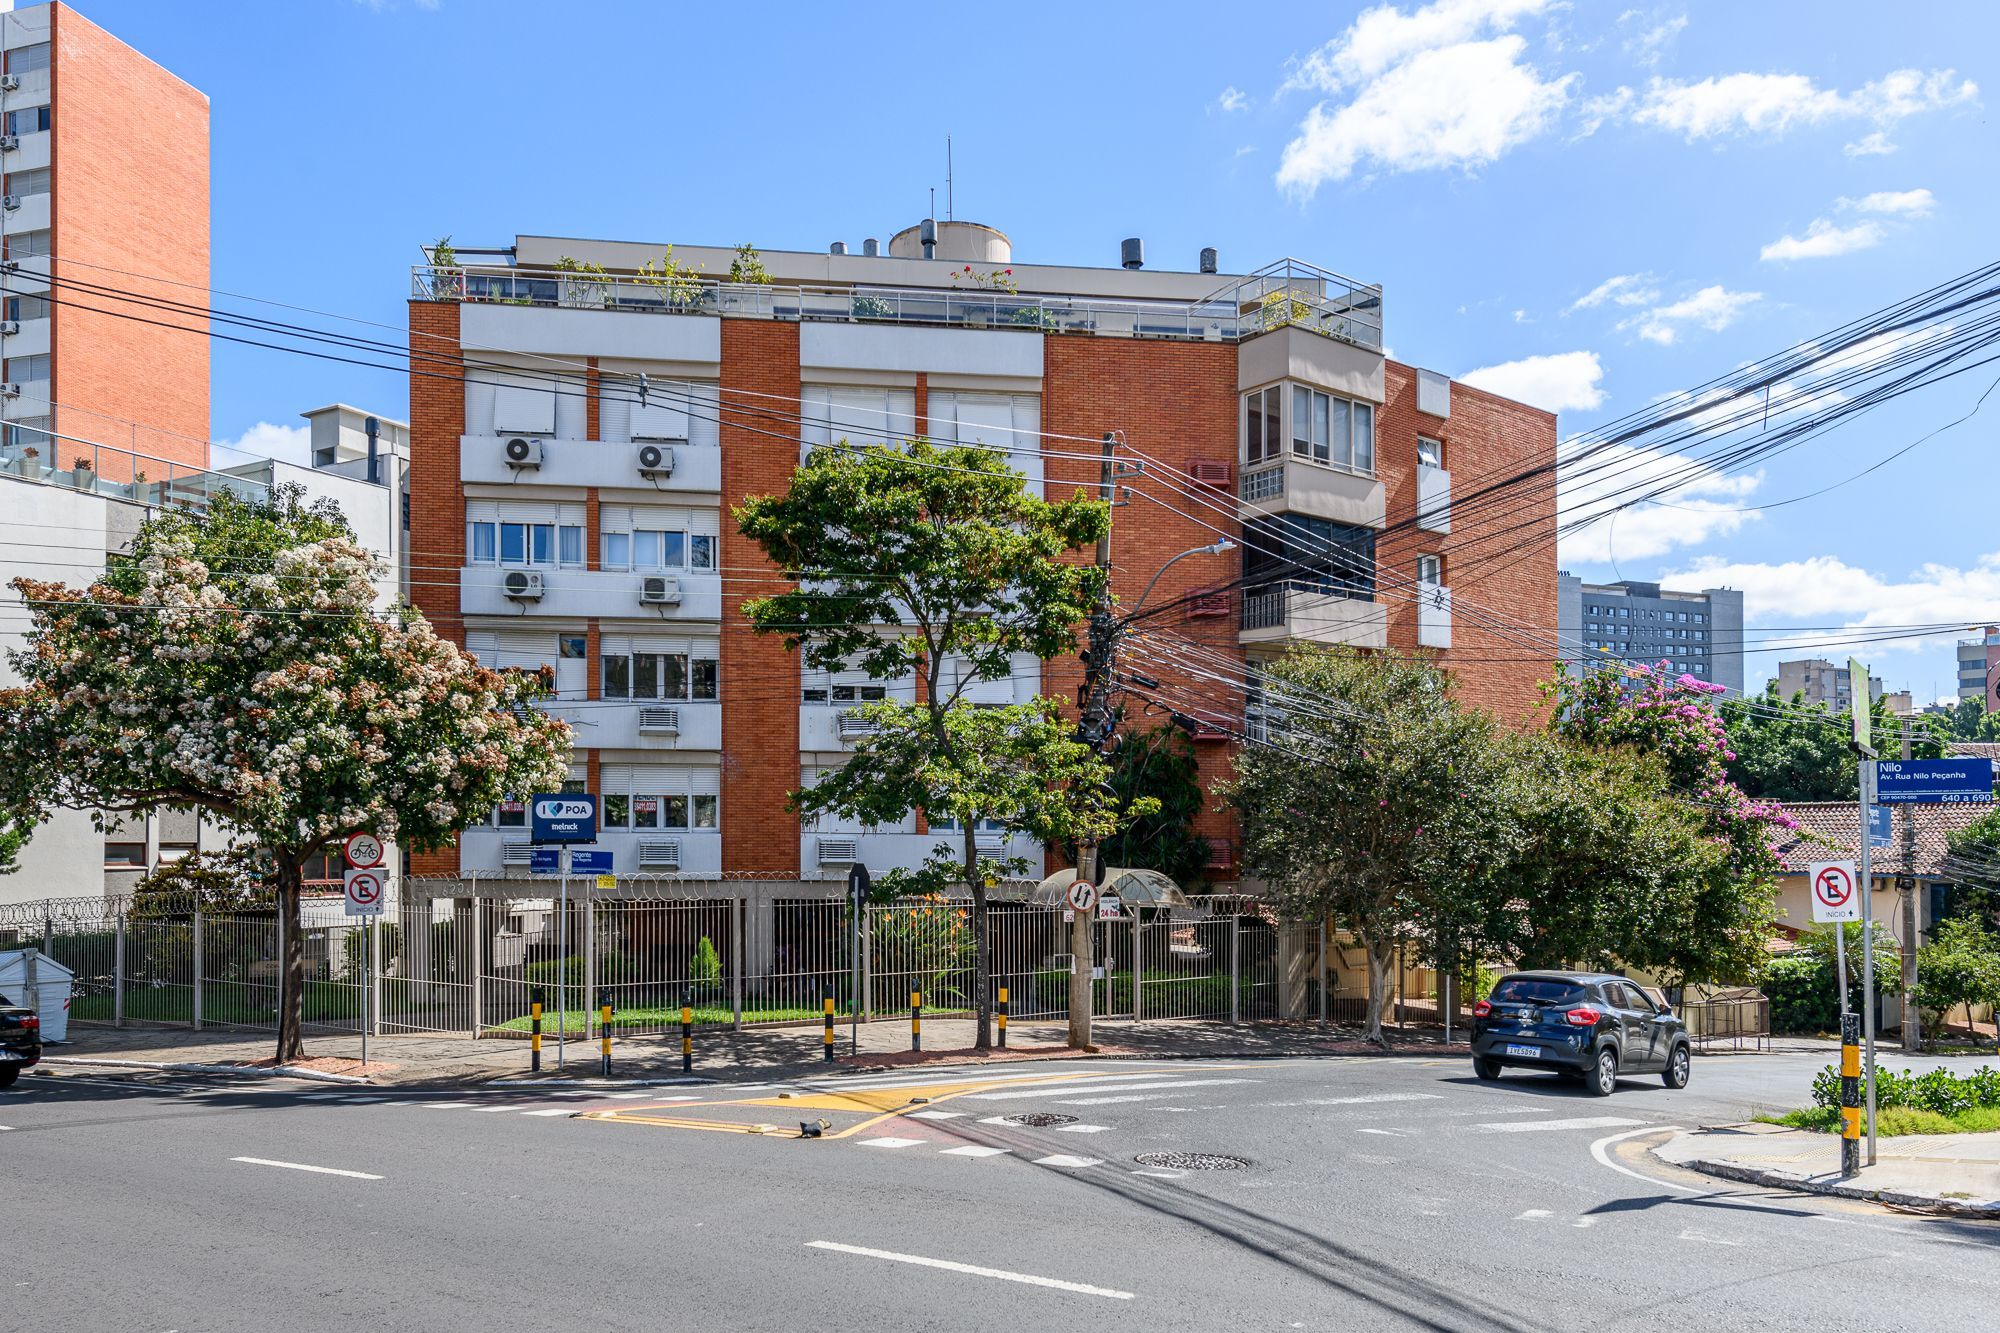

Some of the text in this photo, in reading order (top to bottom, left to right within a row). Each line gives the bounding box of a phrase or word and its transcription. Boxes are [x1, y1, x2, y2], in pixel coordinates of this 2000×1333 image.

[1880, 763, 1902, 772] Nilo
[1931, 772, 1966, 780] Peçanha
[1941, 794, 1960, 802] 640
[1972, 793, 1991, 801] 690
[566, 806, 587, 814] POA
